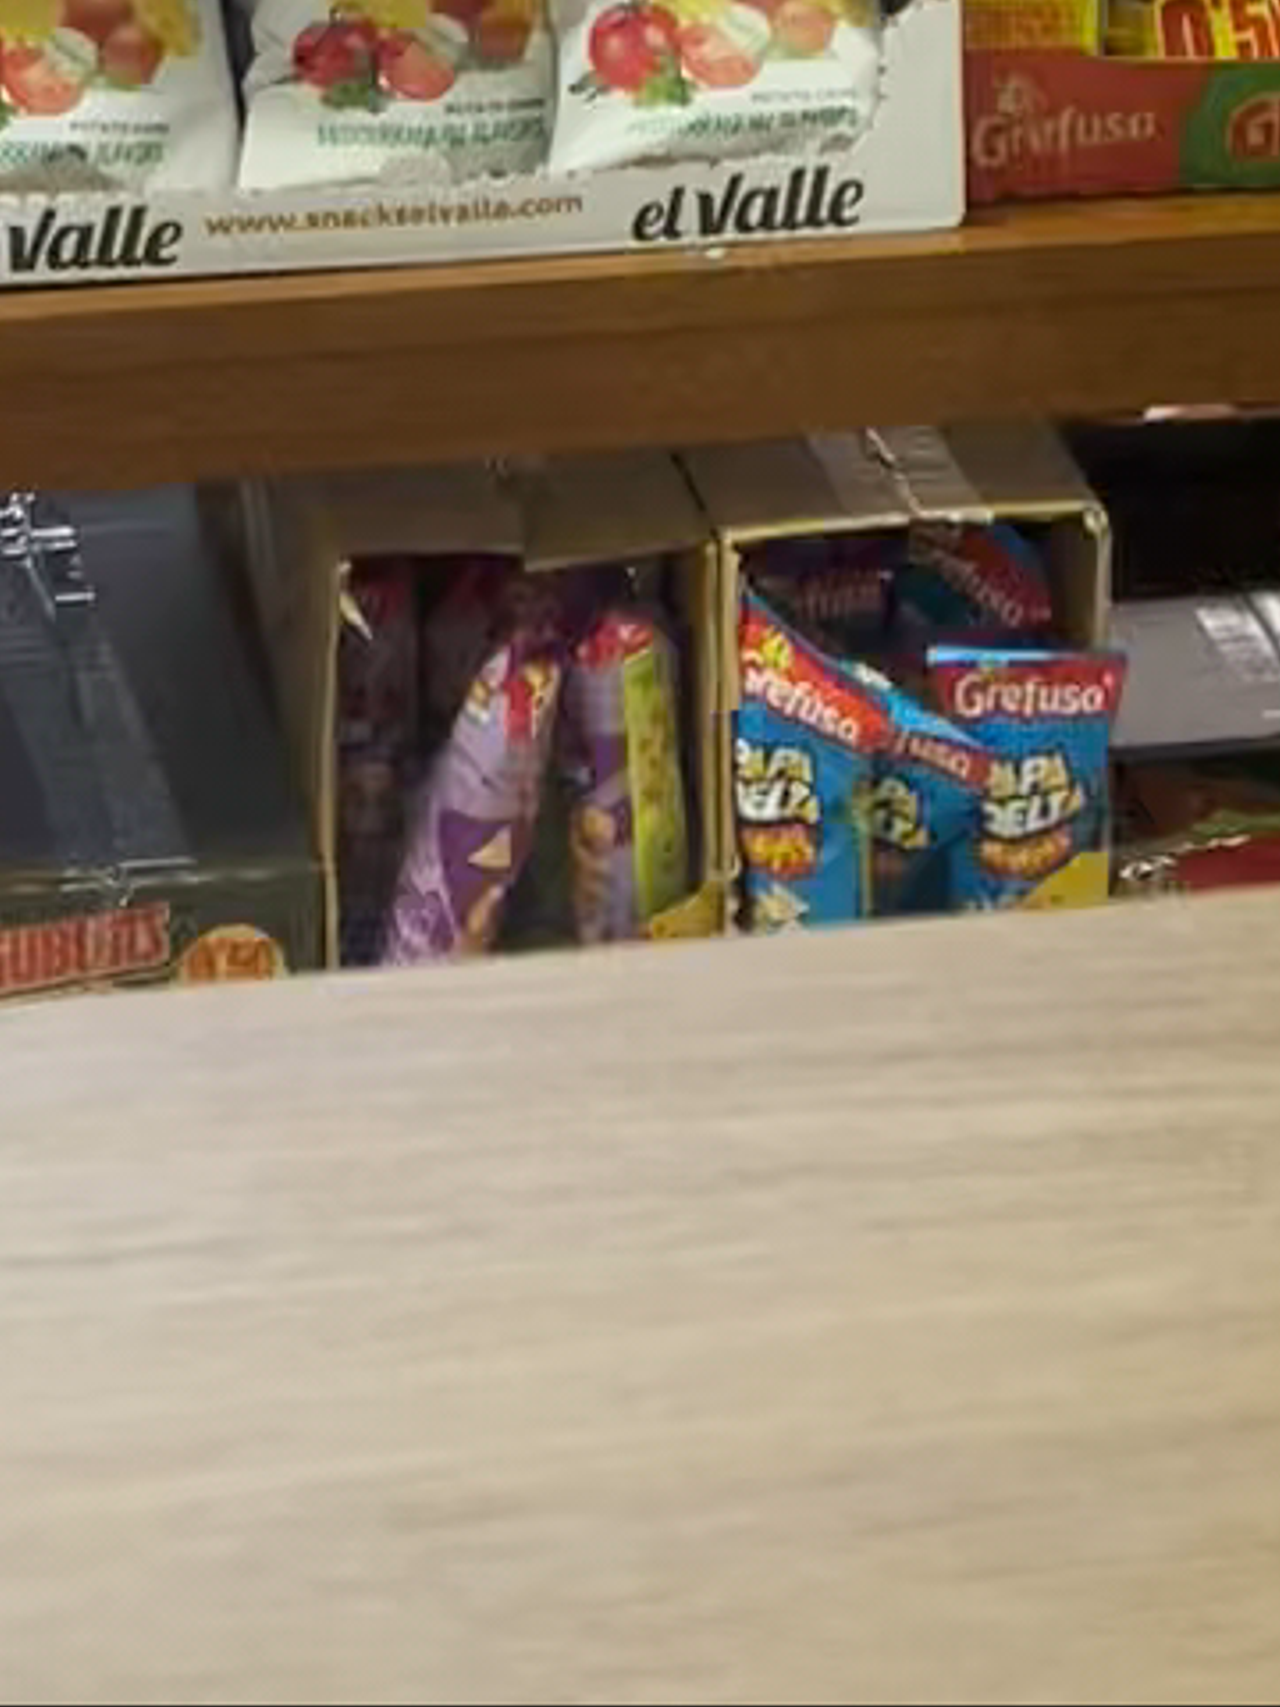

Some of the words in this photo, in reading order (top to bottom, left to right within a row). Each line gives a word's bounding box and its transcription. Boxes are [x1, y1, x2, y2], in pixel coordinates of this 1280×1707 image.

[6, 203, 184, 274] Valle
[631, 185, 686, 243] el
[696, 164, 865, 238] Valle
[954, 665, 1106, 717] Grefusa
